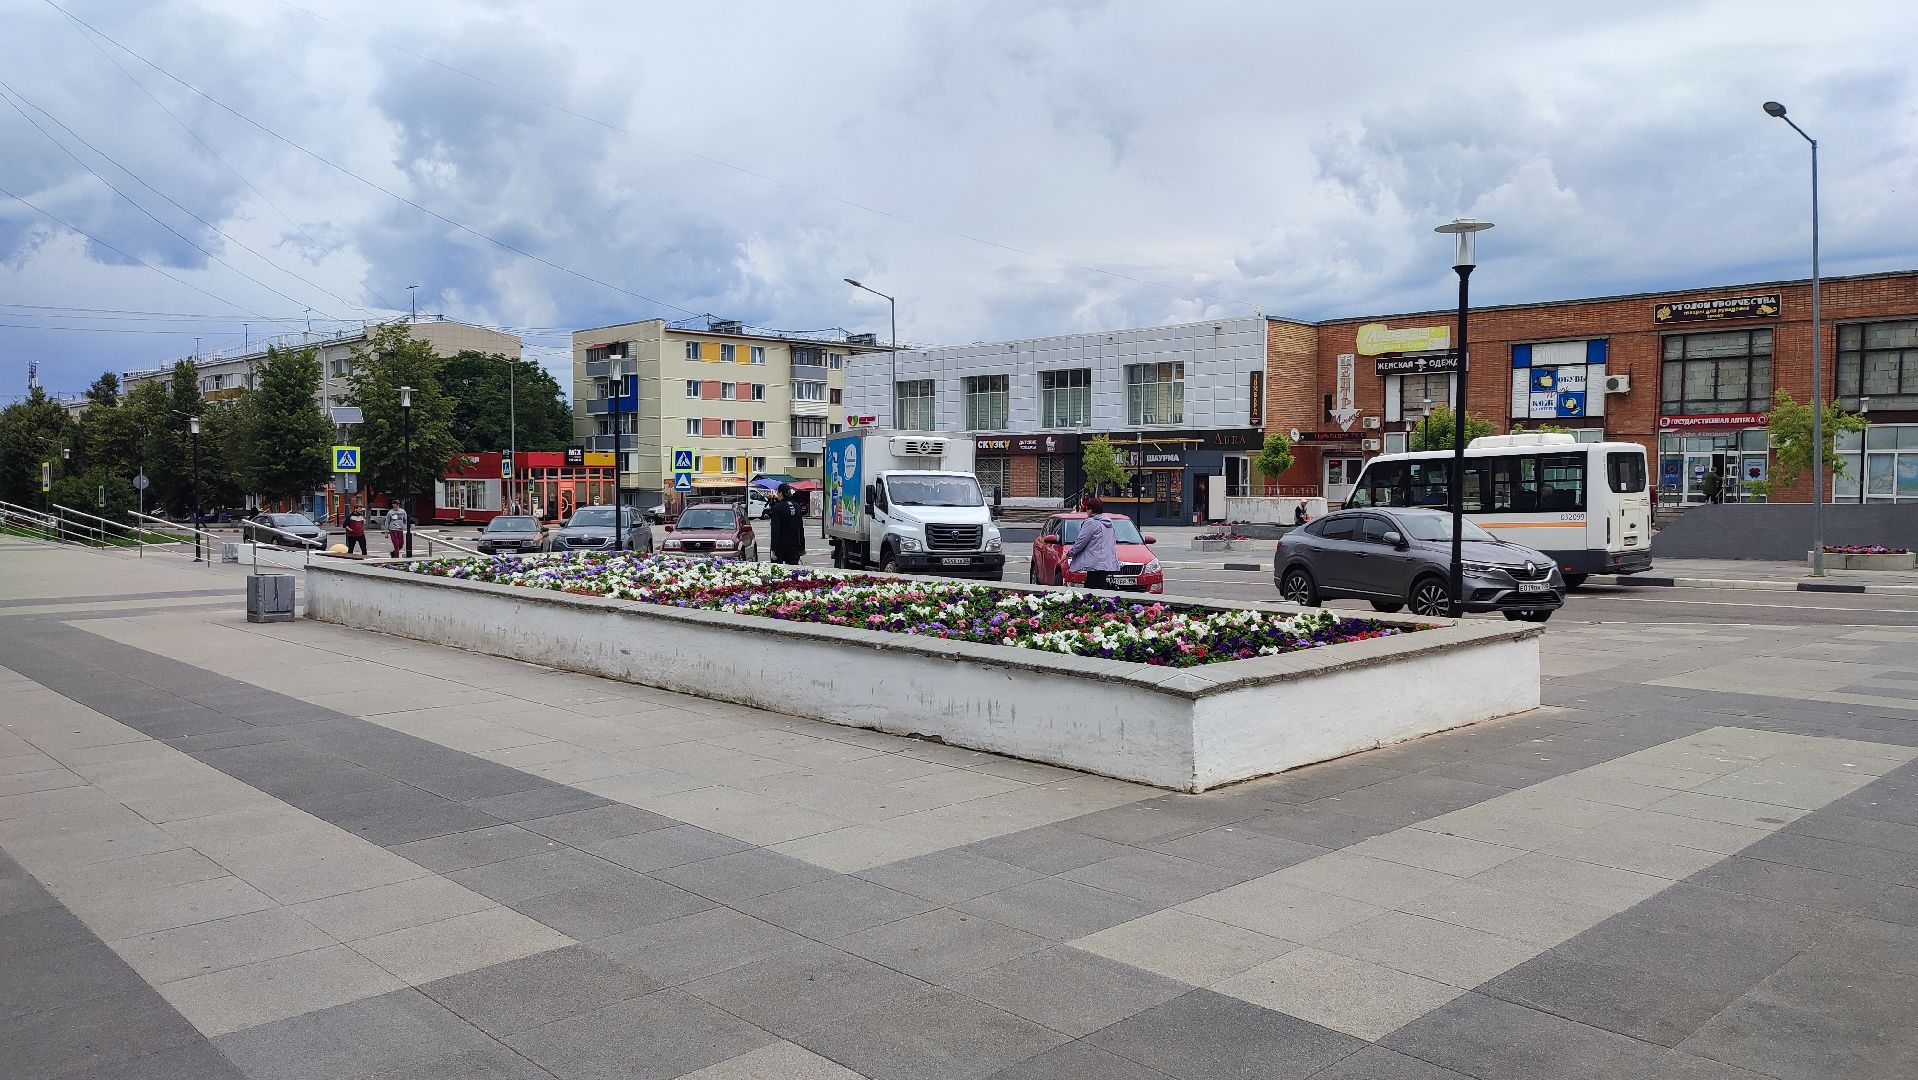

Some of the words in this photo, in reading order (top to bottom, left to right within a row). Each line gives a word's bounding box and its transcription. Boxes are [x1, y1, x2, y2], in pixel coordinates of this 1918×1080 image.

[1377, 360, 1413, 370] ЖЕНСКАЯ
[1428, 358, 1458, 369] ОДЕЖД
[1557, 375, 1587, 384] ОБУВЬ
[1670, 417, 1730, 426] ГОСУДАРСТВЕННАЯ
[1729, 416, 1756, 424] АПТЕКА
[1146, 454, 1180, 462] ШАУРМА
[1560, 513, 1585, 521] 032099
